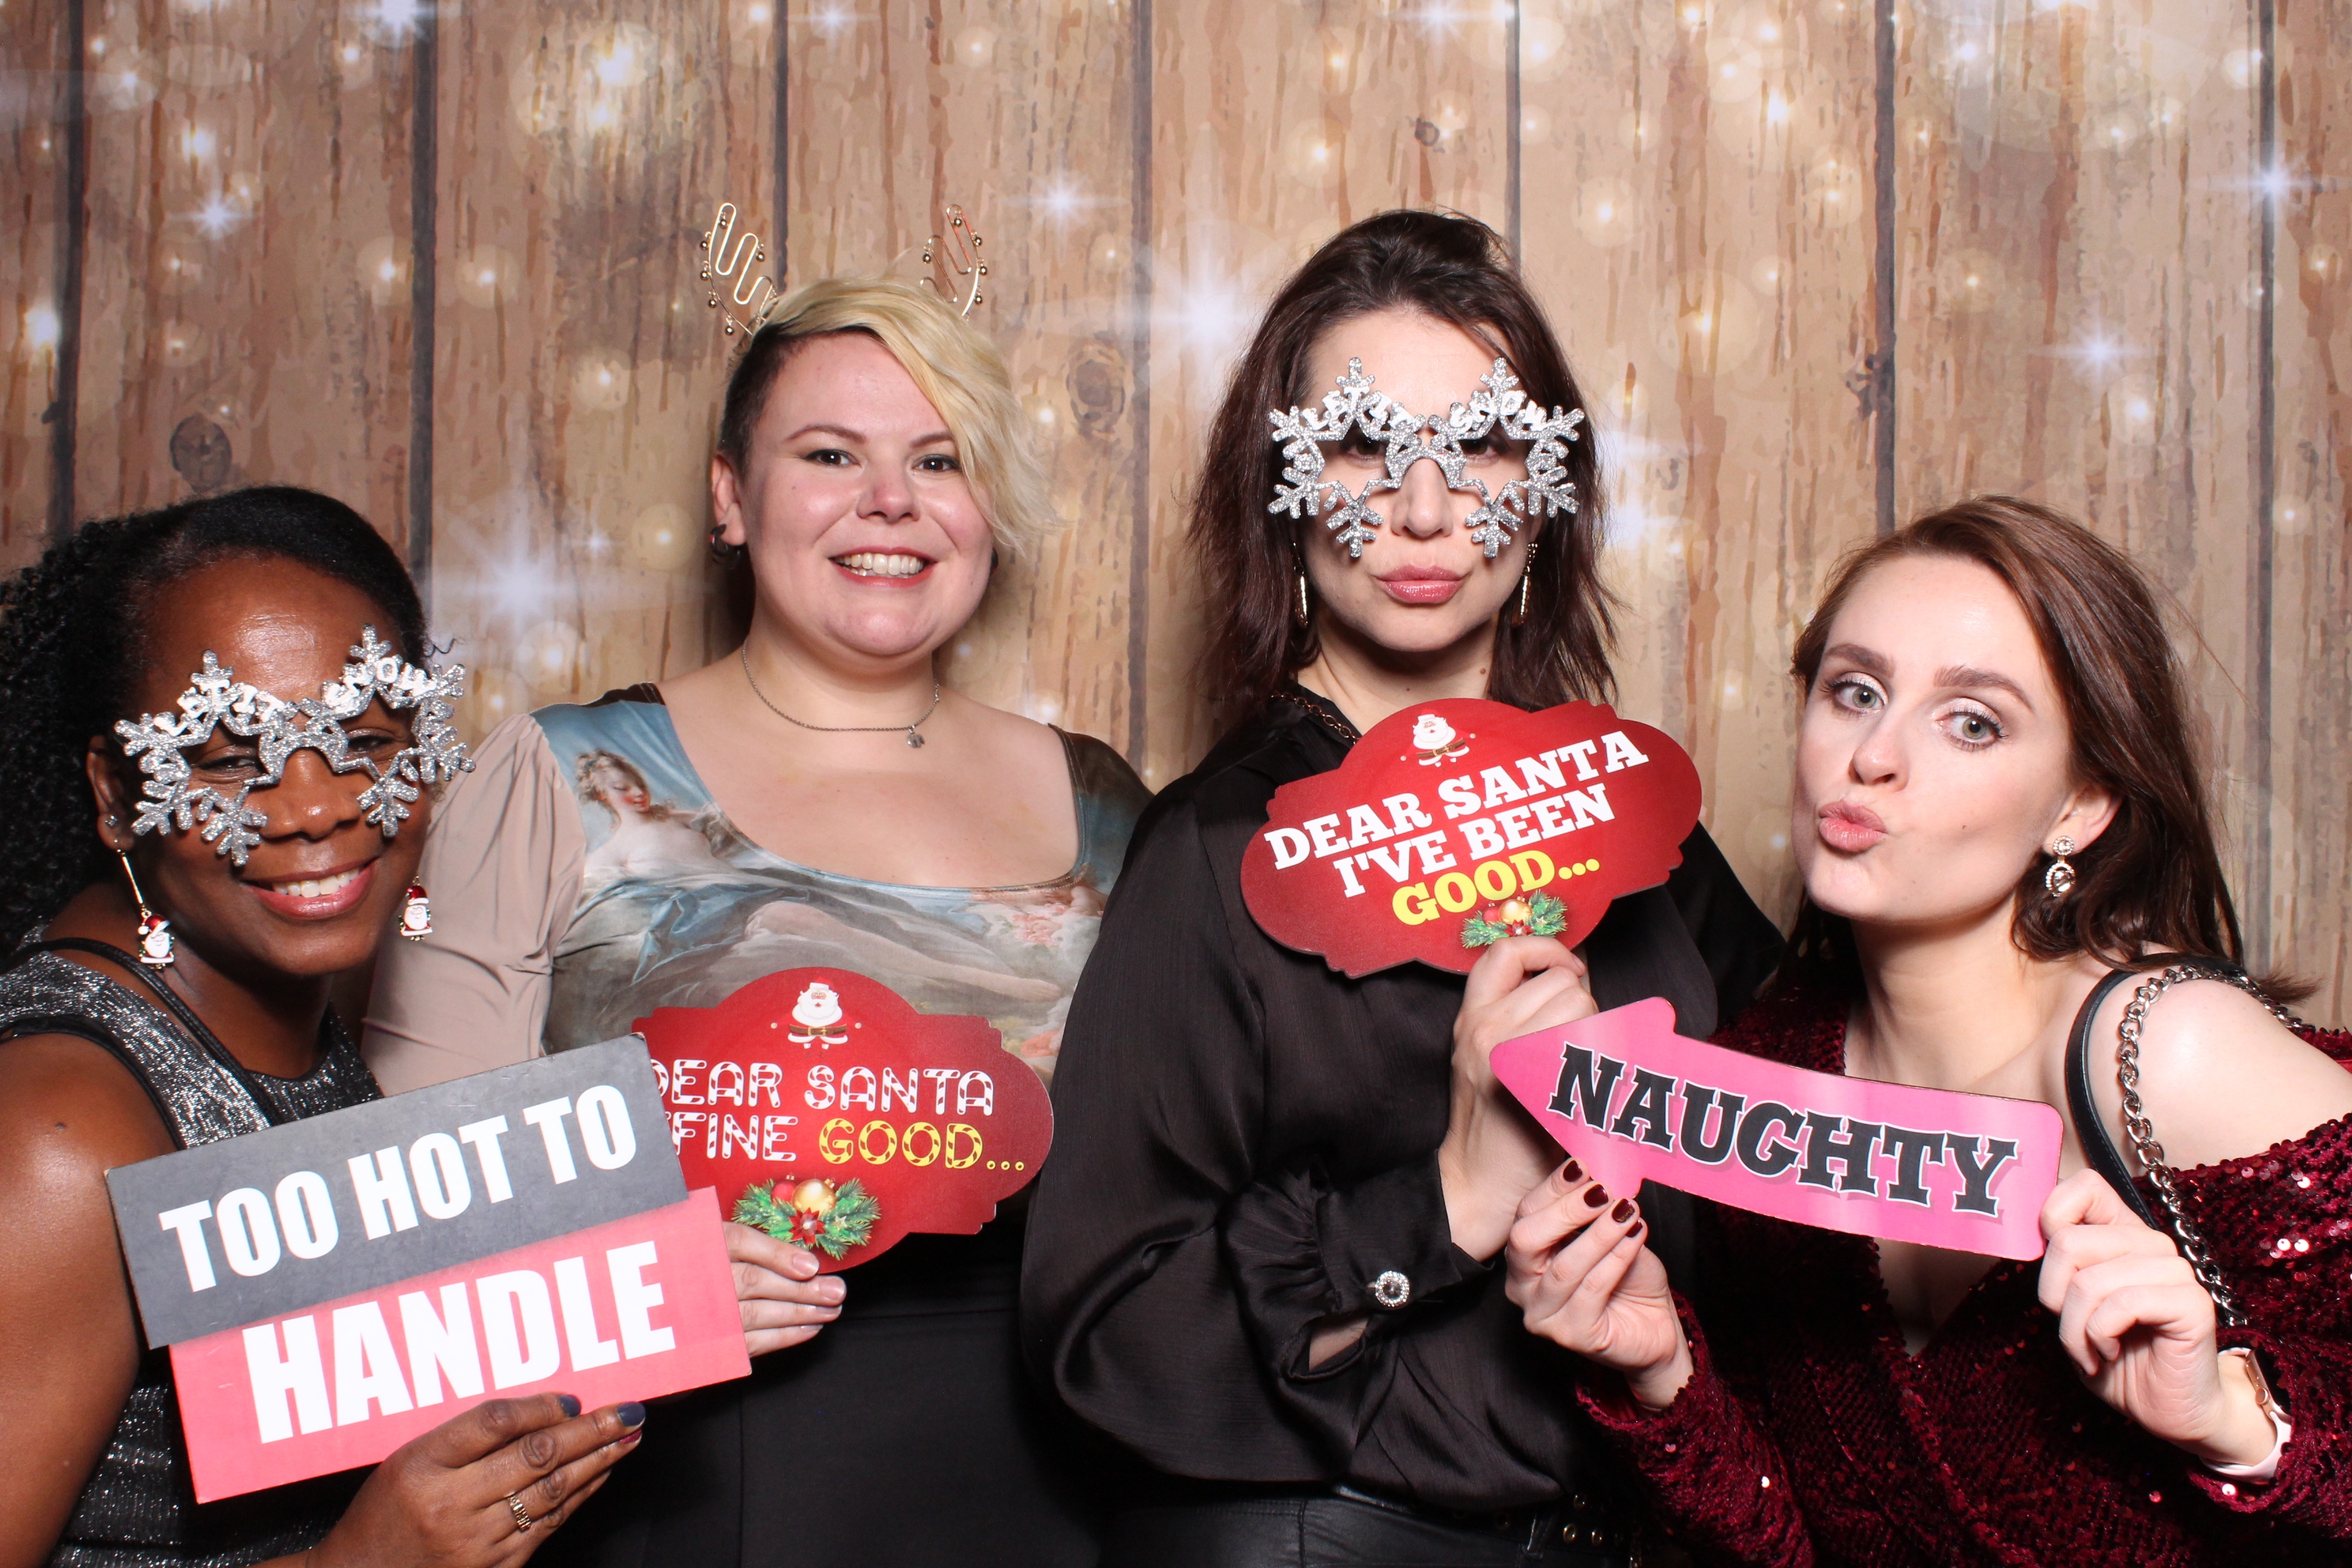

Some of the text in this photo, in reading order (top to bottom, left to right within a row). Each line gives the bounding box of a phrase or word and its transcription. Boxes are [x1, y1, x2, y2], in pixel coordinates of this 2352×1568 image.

[1301, 386, 1371, 431] LET
[152, 679, 231, 736] LET
[324, 657, 437, 713] SNOW
[1264, 731, 1649, 870] DEAR SANTA
[1333, 783, 1614, 898] I'VE BEEN
[1392, 850, 1600, 926] GOOD...
[804, 1064, 994, 1116] SANTA
[1546, 1042, 2019, 1218] NAUGHTY
[159, 1085, 636, 1292] TOO HOT TO
[665, 1111, 1024, 1171] FINE GOOD...
[243, 1241, 676, 1443] HANDLE
